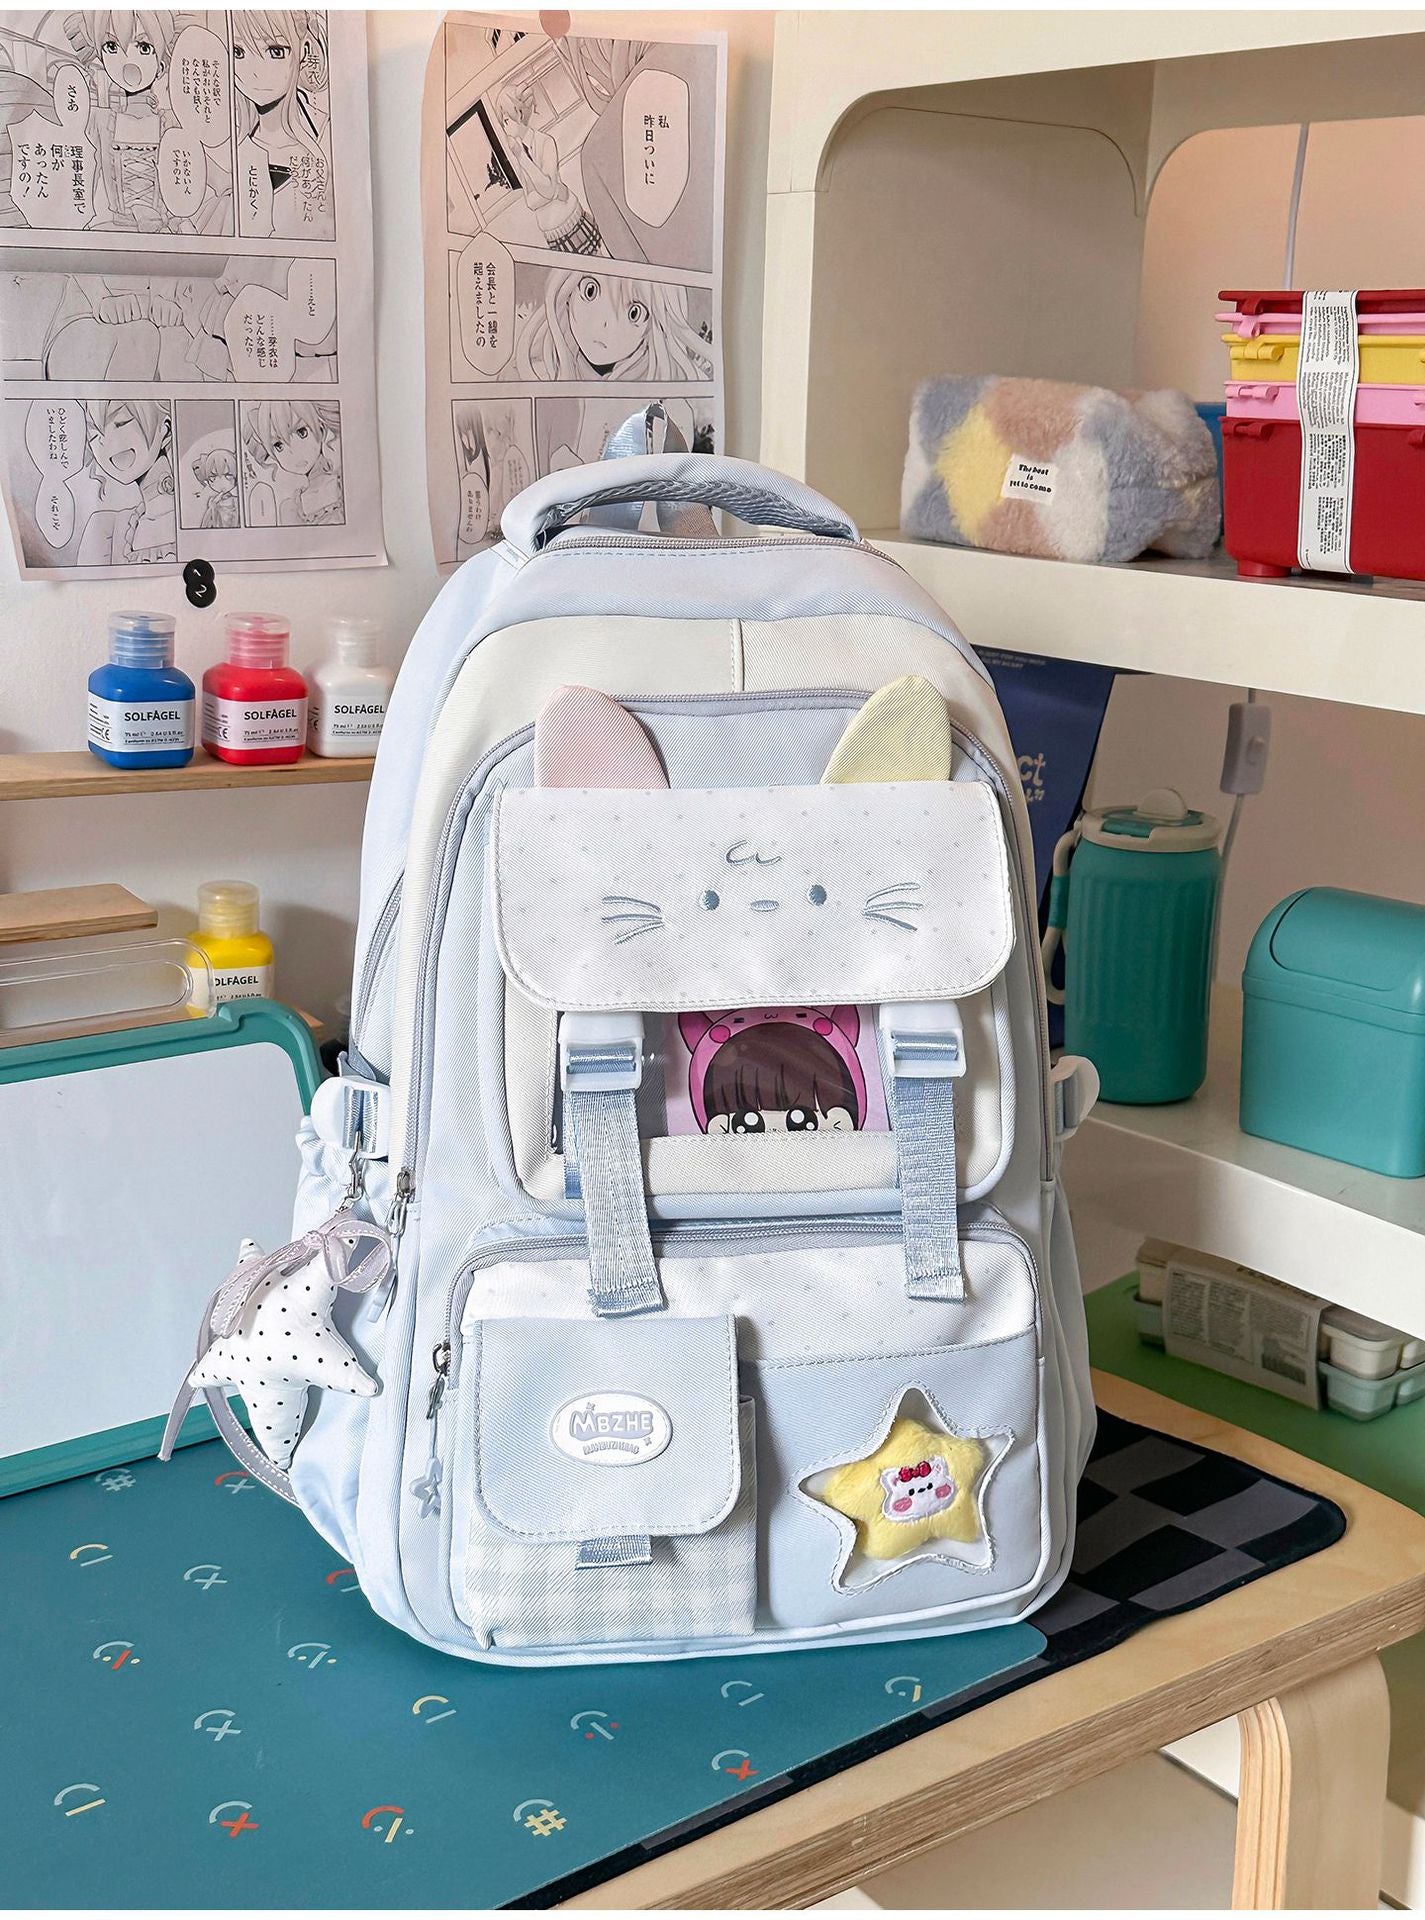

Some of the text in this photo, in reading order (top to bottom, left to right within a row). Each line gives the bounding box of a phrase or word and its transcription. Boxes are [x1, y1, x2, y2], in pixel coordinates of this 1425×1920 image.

[66, 85, 79, 112] さあ
[658, 115, 670, 129] 私
[50, 144, 65, 171] 何が
[643, 115, 656, 186] 昨日ついに
[34, 143, 49, 198] あったん
[71, 145, 86, 215] 理事長室で
[124, 710, 181, 722] SOLFÅGEL
[244, 709, 297, 720] SOLFÅGEL
[334, 704, 385, 714] SOLFÅGEL
[571, 1411, 653, 1434] MBZHE
